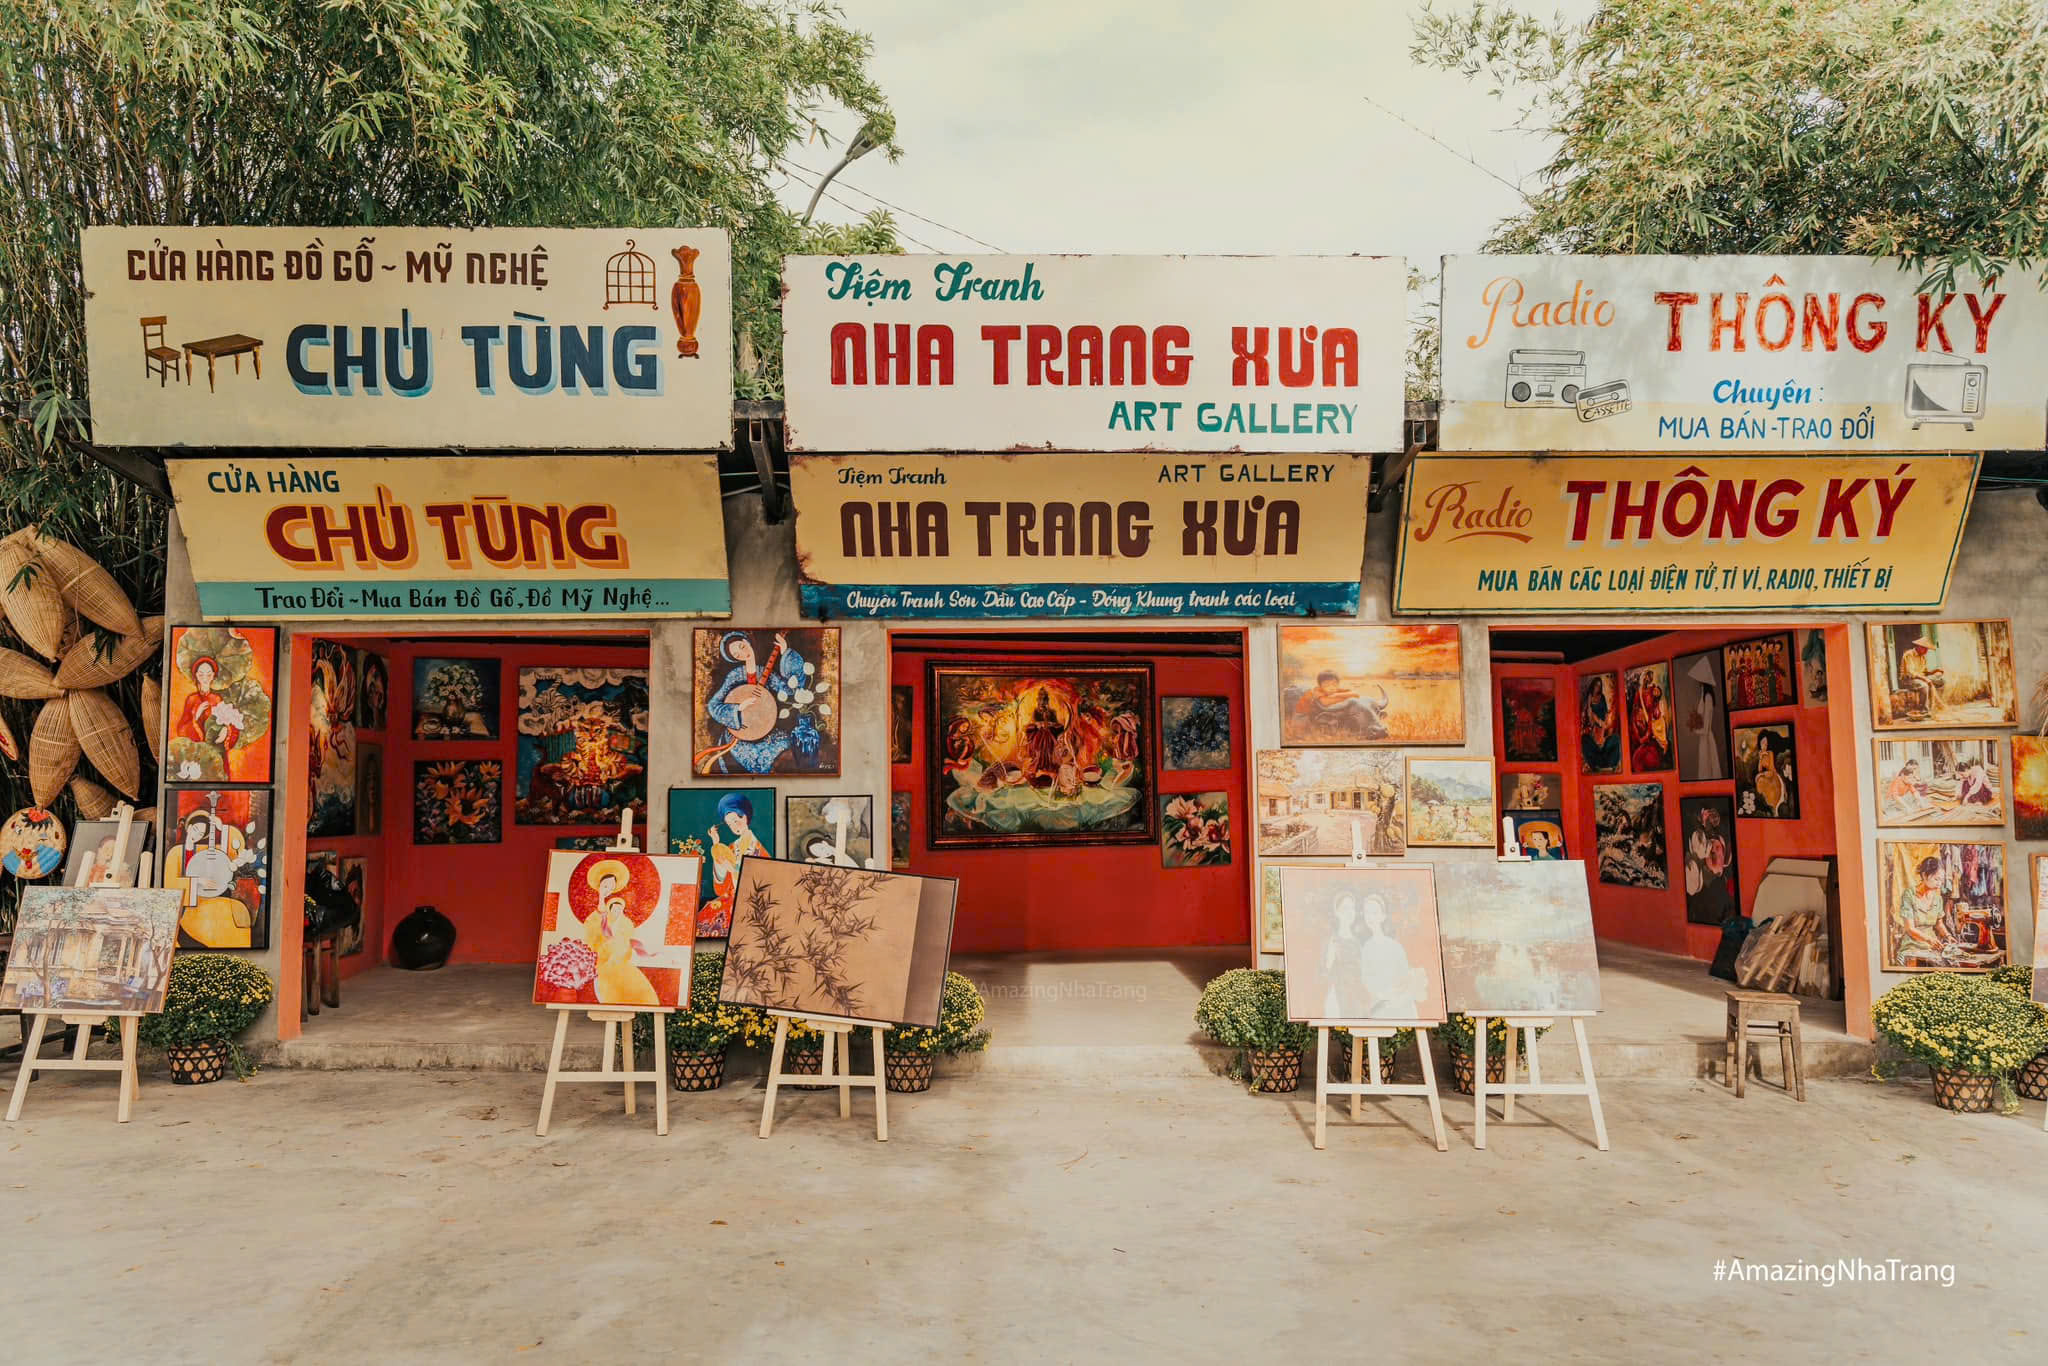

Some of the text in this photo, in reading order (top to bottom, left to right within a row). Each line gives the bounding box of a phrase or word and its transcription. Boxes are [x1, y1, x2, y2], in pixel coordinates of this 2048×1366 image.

[128, 238, 186, 281] CỬA
[197, 238, 274, 281] HÀNG
[284, 237, 324, 281] ĐỒ
[333, 237, 376, 282] GỖ
[406, 242, 452, 284] MỸ
[466, 244, 549, 291] NGHỆ
[825, 261, 1045, 307] Tiệm Tranh
[1467, 275, 1616, 349] Radio
[1654, 273, 1888, 355] THÔNG
[461, 311, 664, 396] TÙNG
[830, 321, 1360, 388] NHA TRANG XƯA
[1108, 401, 1359, 435] ART GALLERY
[1658, 416, 1710, 439] MUA
[1720, 410, 1766, 439] BÁN
[208, 463, 340, 493] CỬA HÀNG
[837, 466, 947, 488] Tiệm Tranh
[1158, 464, 1336, 483] ART GALLERY
[839, 494, 1301, 558] NHA TRANG XƯA
[1414, 481, 1534, 543] Radio
[1564, 463, 1917, 546] THÔNG KÝ
[254, 587, 306, 609] Trao
[310, 587, 344, 609] Đổi
[409, 588, 447, 608] Bán
[454, 587, 482, 608] Đồ
[562, 588, 594, 612] Mỹ
[847, 590, 898, 615] Chuyên
[900, 591, 944, 608] Tranh
[949, 590, 977, 608] Sơn
[1020, 591, 1045, 608] Cao
[1047, 589, 1076, 614] Cấp
[1092, 589, 1132, 613] Đóng
[1135, 590, 1184, 612] Khung
[1189, 590, 1230, 607] tranh
[1234, 588, 1261, 607] các
[1264, 589, 1296, 609] loại
[1477, 568, 1519, 591] MUA
